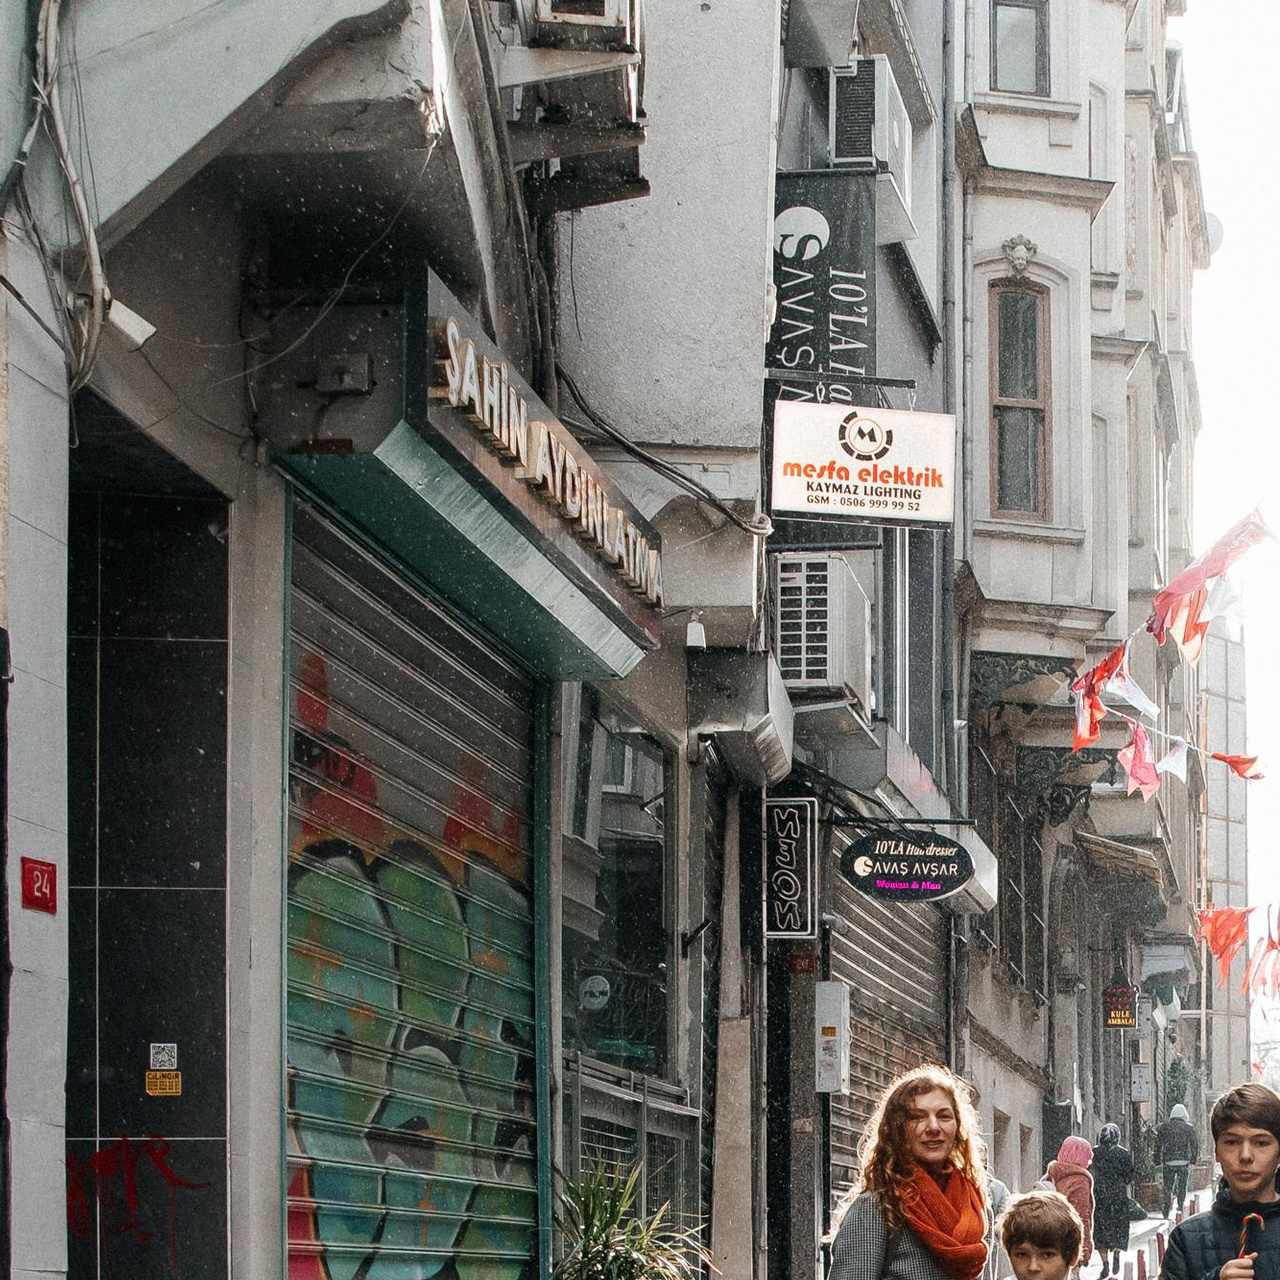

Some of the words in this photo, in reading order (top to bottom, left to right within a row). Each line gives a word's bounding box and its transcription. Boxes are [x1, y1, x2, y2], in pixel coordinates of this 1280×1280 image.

[446, 316, 528, 469] ŞAHİN
[532, 421, 665, 612] AYDINLATMA
[783, 460, 850, 480] mesfa
[857, 463, 944, 488] elektrik
[806, 481, 860, 496] KAYMAZ
[863, 486, 922, 500] LIGHTING
[806, 495, 830, 505] GSM
[840, 497, 866, 507] 0506
[869, 498, 888, 509] 999
[891, 500, 904, 510] 99
[908, 502, 920, 511] 52
[905, 843, 958, 856] Hadresser
[912, 862, 958, 877] AVŞAR
[34, 870, 50, 899] 24
[1107, 1018, 1135, 1026] AMBALAJ
[1110, 1010, 1130, 1018] KULE
